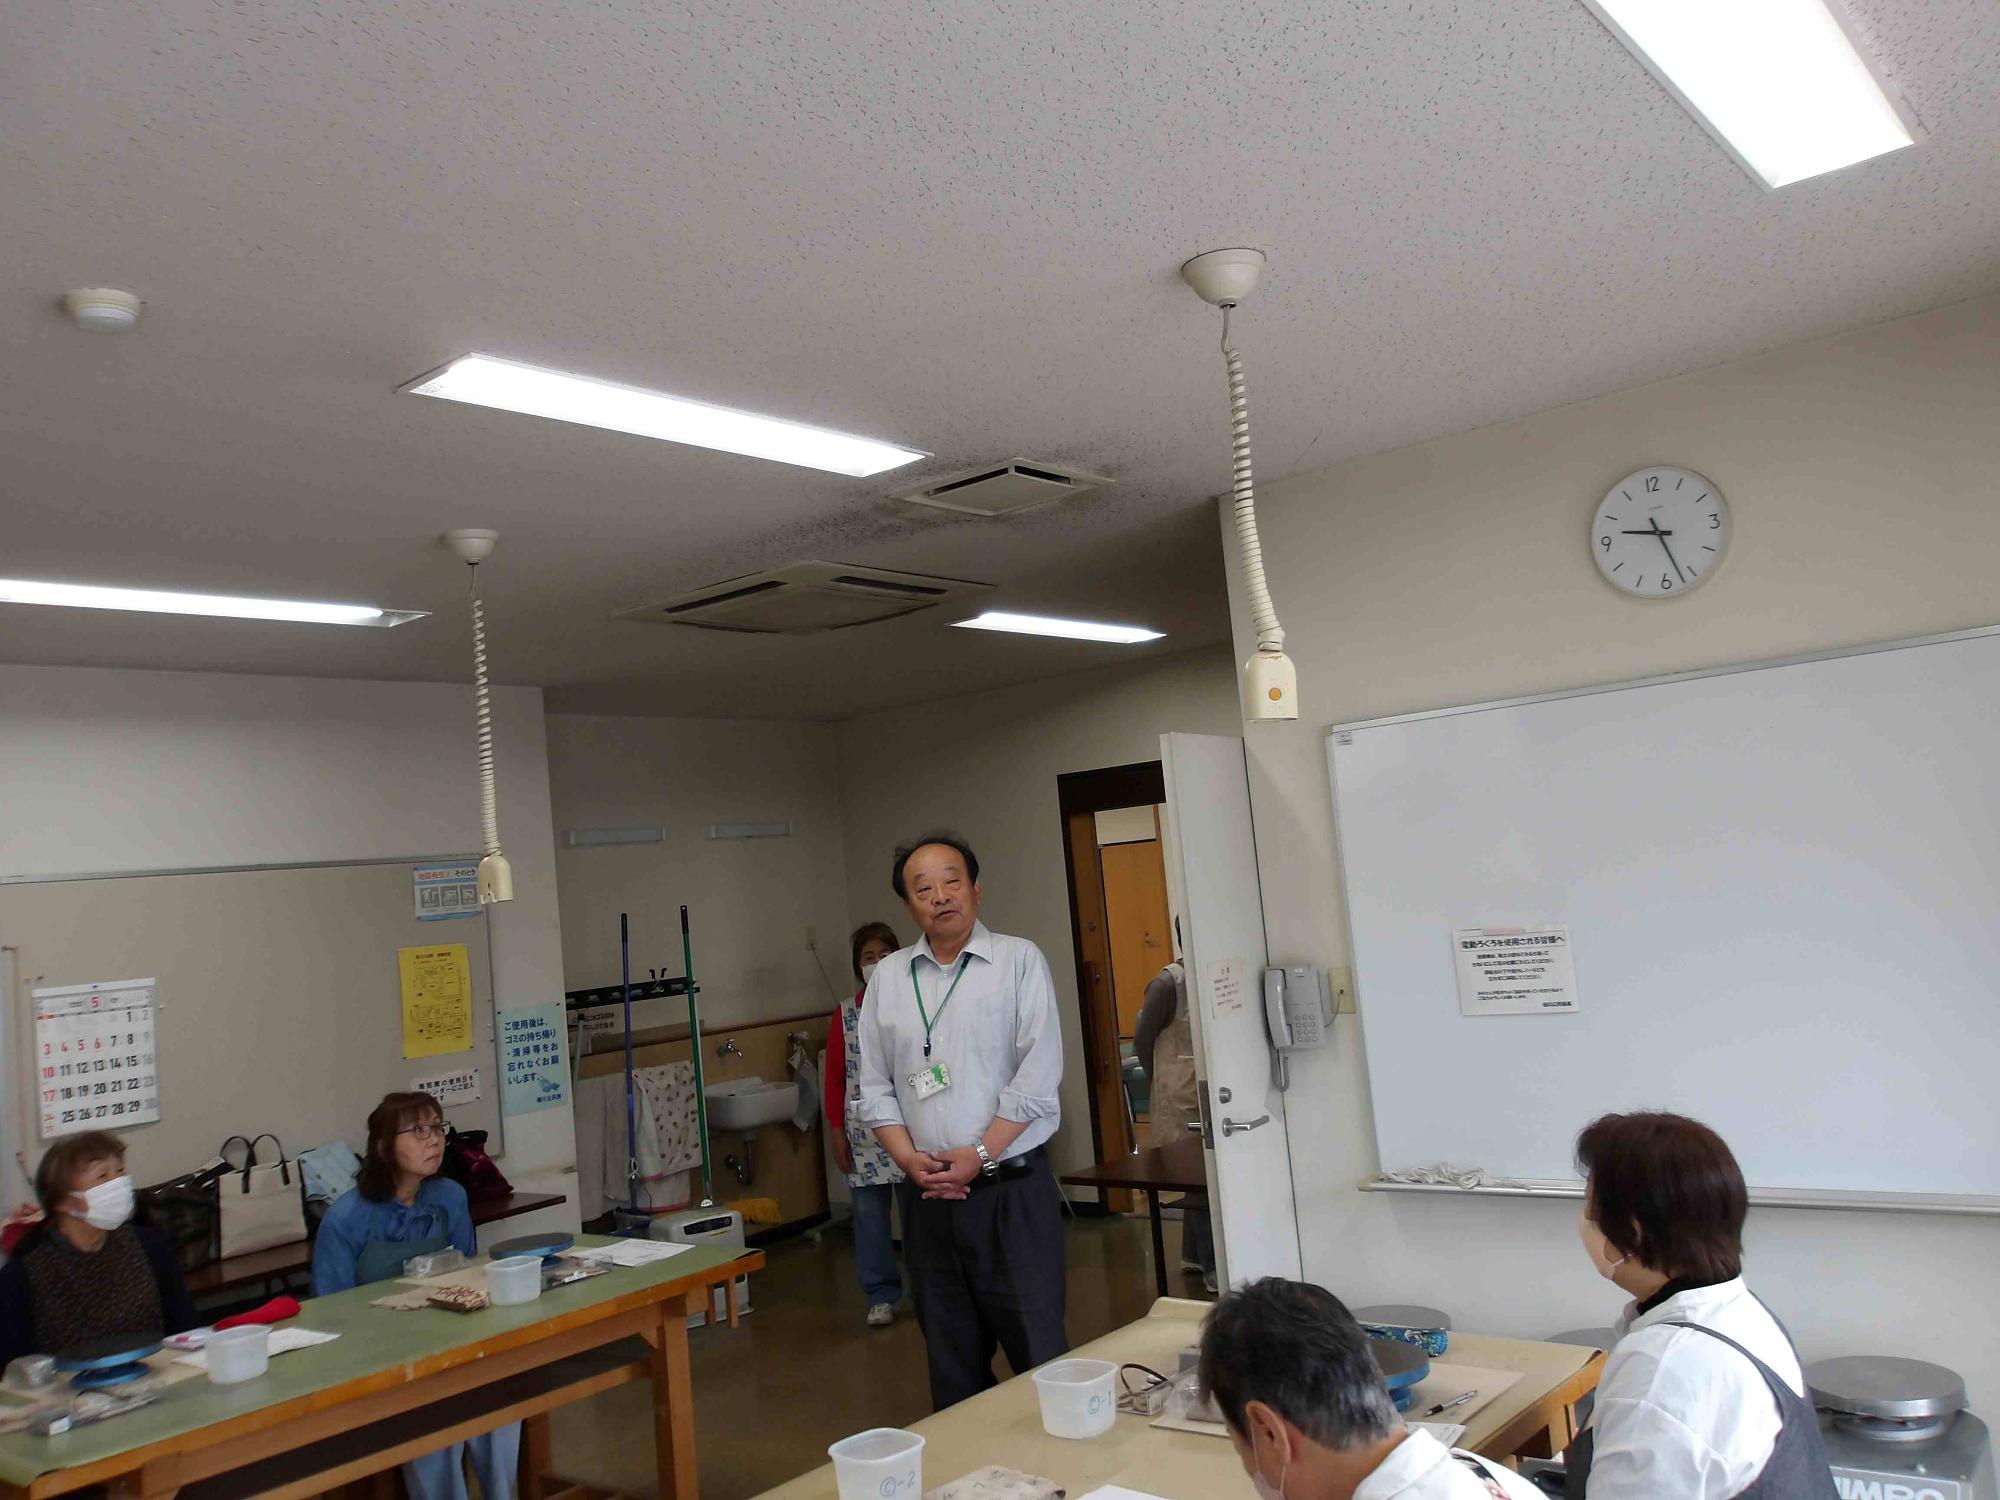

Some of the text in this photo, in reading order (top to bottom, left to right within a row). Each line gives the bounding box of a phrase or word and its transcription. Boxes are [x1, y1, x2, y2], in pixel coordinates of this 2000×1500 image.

[1645, 476, 1660, 493] 12
[1708, 513, 1720, 529] 3
[1600, 536, 1612, 552] 9
[1661, 573, 1672, 590] 6
[91, 996, 99, 1009] 5
[127, 1011, 132, 1022] 1
[505, 1017, 548, 1031] ご使用後は、
[43, 1043, 51, 1055] 3
[61, 1042, 68, 1052] 4
[78, 1039, 86, 1051] 5
[94, 1038, 101, 1049] 6
[110, 1035, 117, 1047] 7
[127, 1033, 133, 1045] 8
[42, 1066, 54, 1079] 10
[61, 1064, 71, 1076] 11
[77, 1062, 89, 1074] 12
[94, 1059, 104, 1072] 13
[110, 1058, 121, 1070] 14
[126, 1055, 138, 1067] 15
[507, 1055, 560, 1072] 忘れなくお願
[42, 1089, 55, 1102] 17
[61, 1087, 72, 1100] 18
[78, 1085, 88, 1097] 19
[94, 1082, 106, 1095] 20
[111, 1080, 121, 1092] 21
[127, 1077, 139, 1090] 22
[62, 1110, 74, 1123] 25
[79, 1107, 91, 1120] 26
[95, 1105, 107, 1118] 27
[112, 1102, 124, 1116] 28
[128, 1100, 140, 1113] 29
